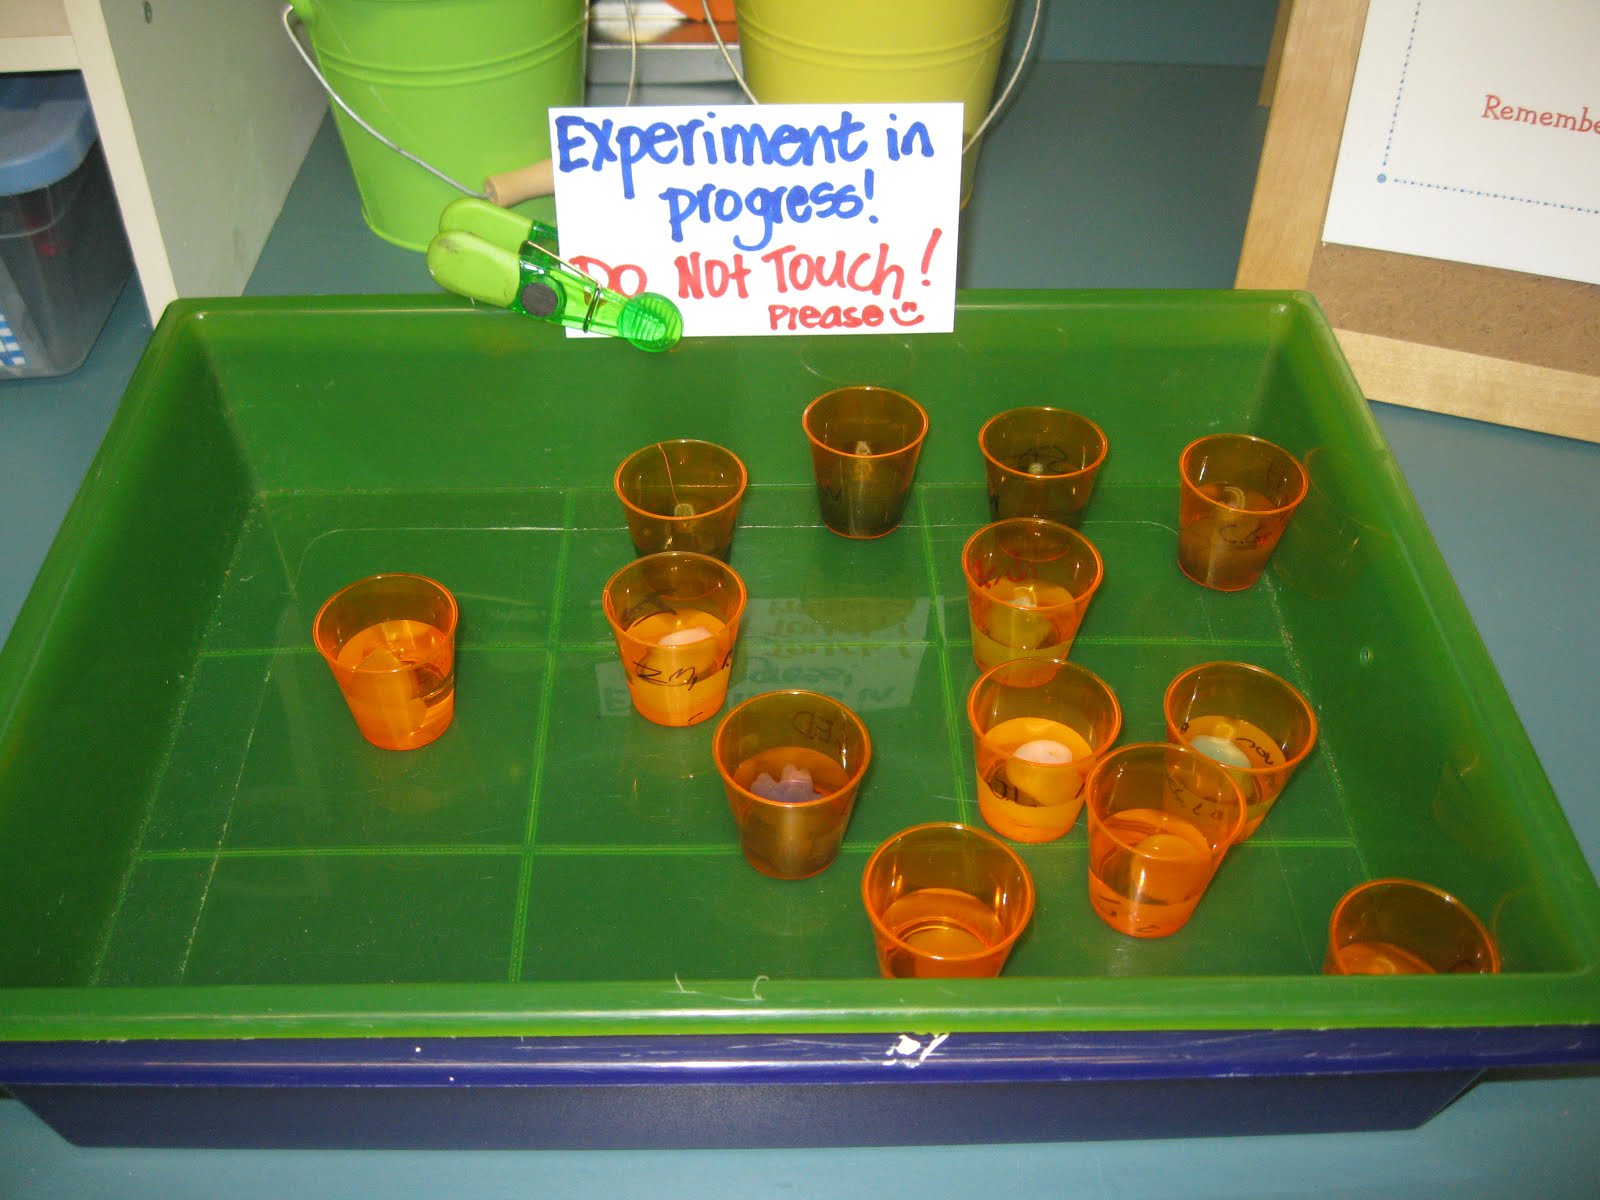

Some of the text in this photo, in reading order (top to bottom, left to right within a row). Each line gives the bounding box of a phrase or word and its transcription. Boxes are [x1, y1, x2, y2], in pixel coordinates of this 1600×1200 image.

[556, 111, 935, 200] Experiment in
[658, 168, 879, 252] progress!
[674, 251, 752, 300] Not
